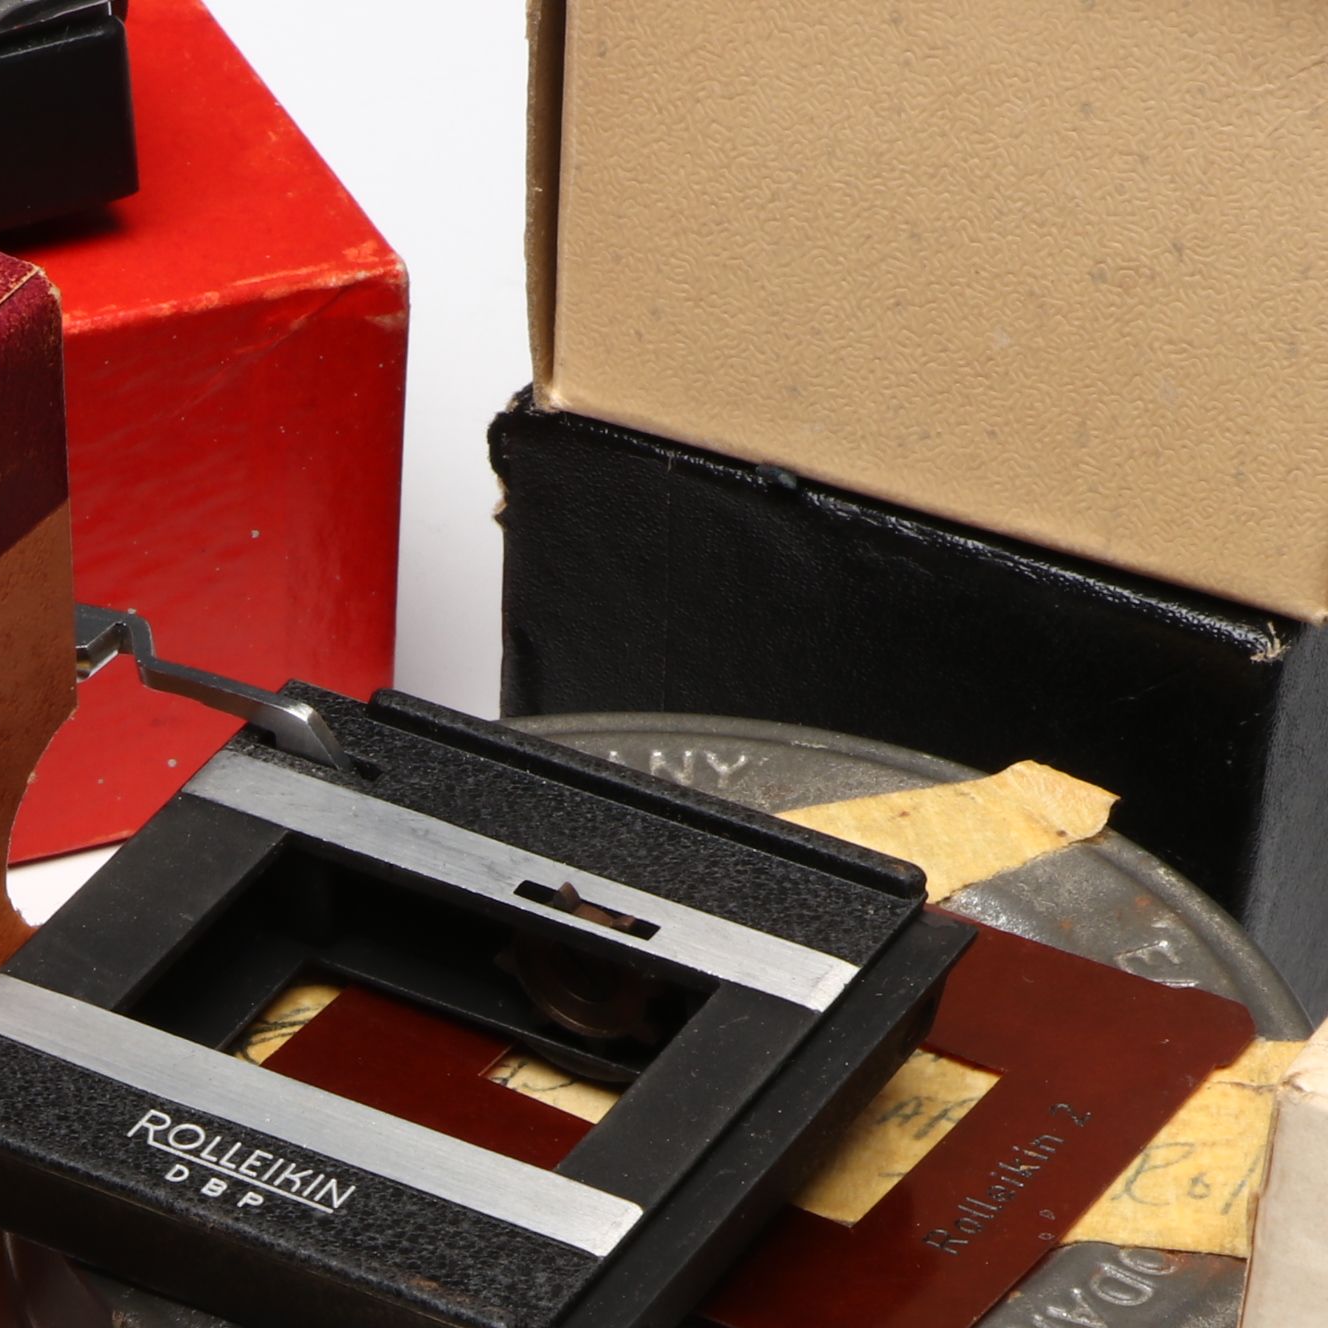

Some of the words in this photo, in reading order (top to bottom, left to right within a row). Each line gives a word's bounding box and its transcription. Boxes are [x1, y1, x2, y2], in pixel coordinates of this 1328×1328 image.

[126, 1107, 357, 1213] ROLLEIKIN
[923, 1133, 1066, 1256] Rolleikin
[1048, 1102, 1093, 1128] 2
